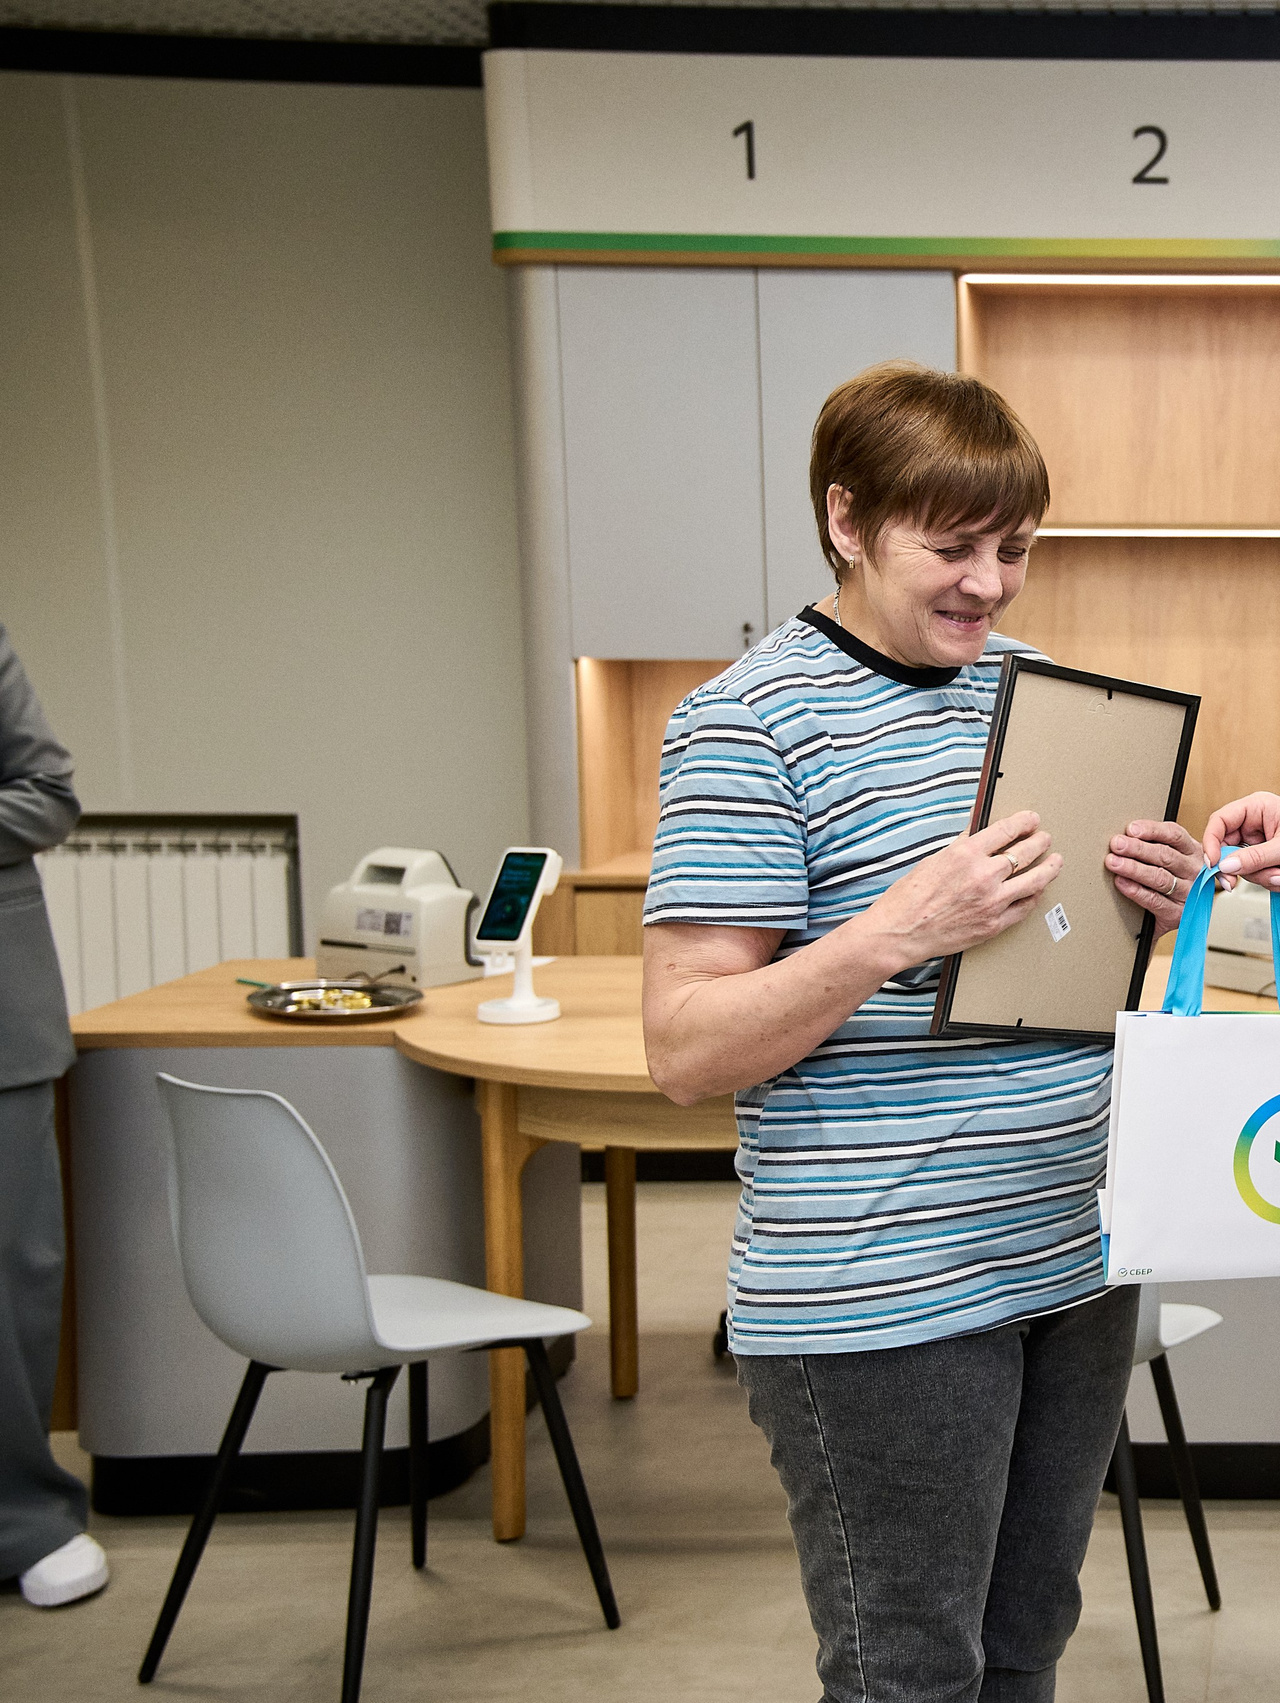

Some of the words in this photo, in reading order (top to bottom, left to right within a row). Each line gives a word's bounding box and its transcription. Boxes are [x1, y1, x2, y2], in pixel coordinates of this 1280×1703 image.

[732, 119, 756, 181] 1
[1132, 125, 1169, 185] 2
[1129, 1268, 1153, 1276] СБЕР
